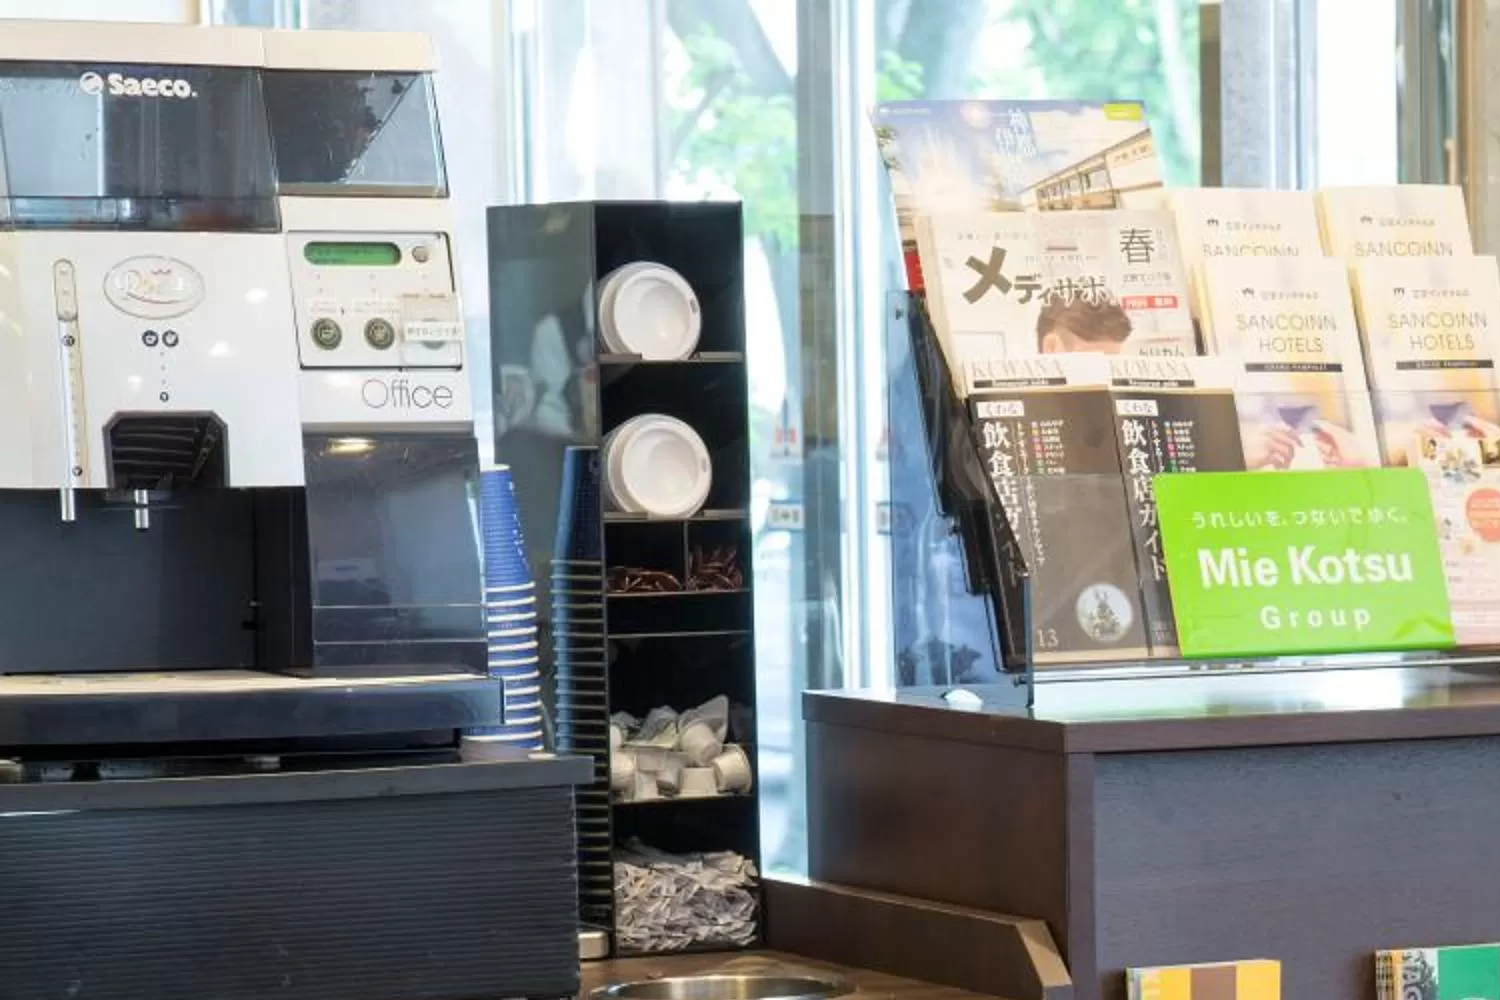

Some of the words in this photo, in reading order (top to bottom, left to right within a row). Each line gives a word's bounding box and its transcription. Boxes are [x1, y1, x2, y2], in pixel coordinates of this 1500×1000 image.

[1119, 227, 1155, 264] 春
[1236, 313, 1338, 331] SANCOINN
[1388, 311, 1488, 330] SANCOINN
[1259, 336, 1323, 354] HOTELS
[1410, 333, 1475, 351] HOTELS
[362, 378, 454, 409] Office
[1192, 506, 1408, 530] うれしいを、つないでゆく。
[1197, 547, 1280, 589] Mie
[1287, 543, 1414, 586] Kotsu
[1260, 604, 1371, 631] Group
